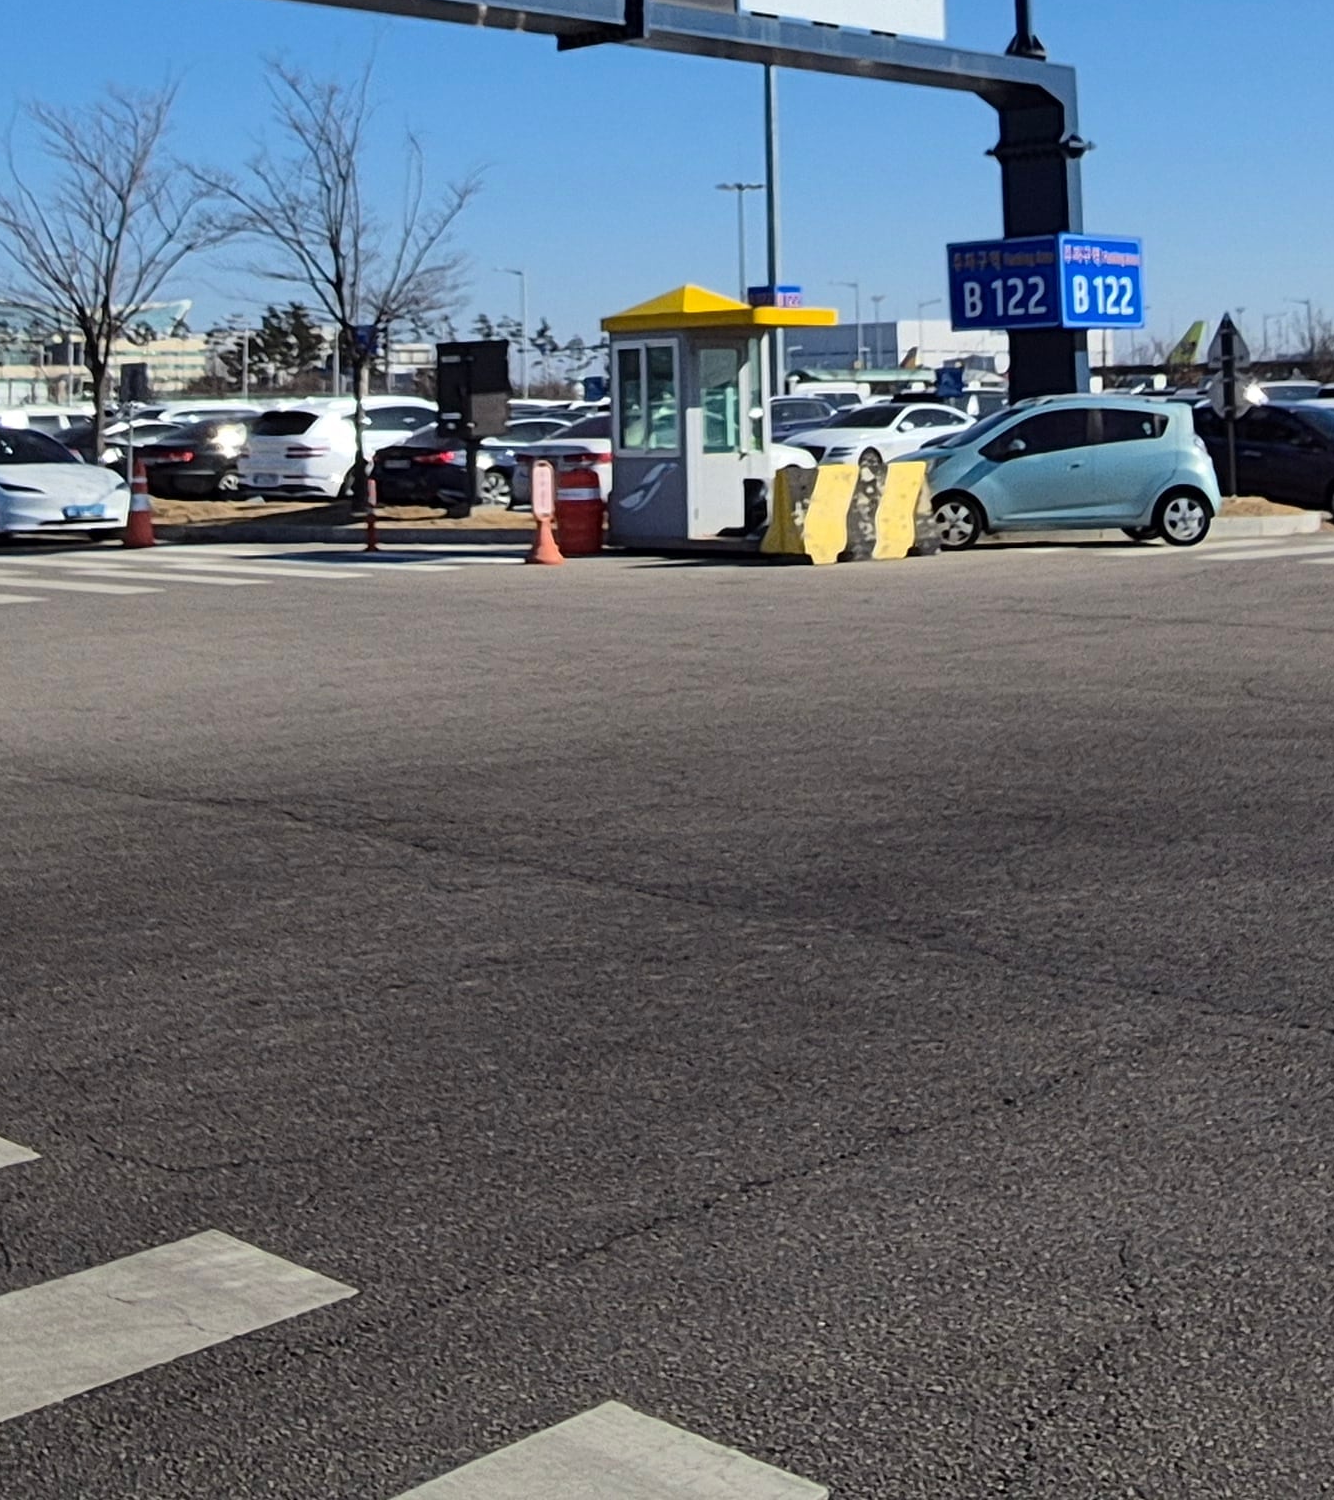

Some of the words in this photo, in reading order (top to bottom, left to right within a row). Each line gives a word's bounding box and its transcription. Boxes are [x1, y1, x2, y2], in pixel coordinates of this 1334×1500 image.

[963, 281, 984, 318] B
[991, 276, 1047, 317] 122
[1072, 274, 1090, 314] B
[1093, 275, 1134, 315] 122
